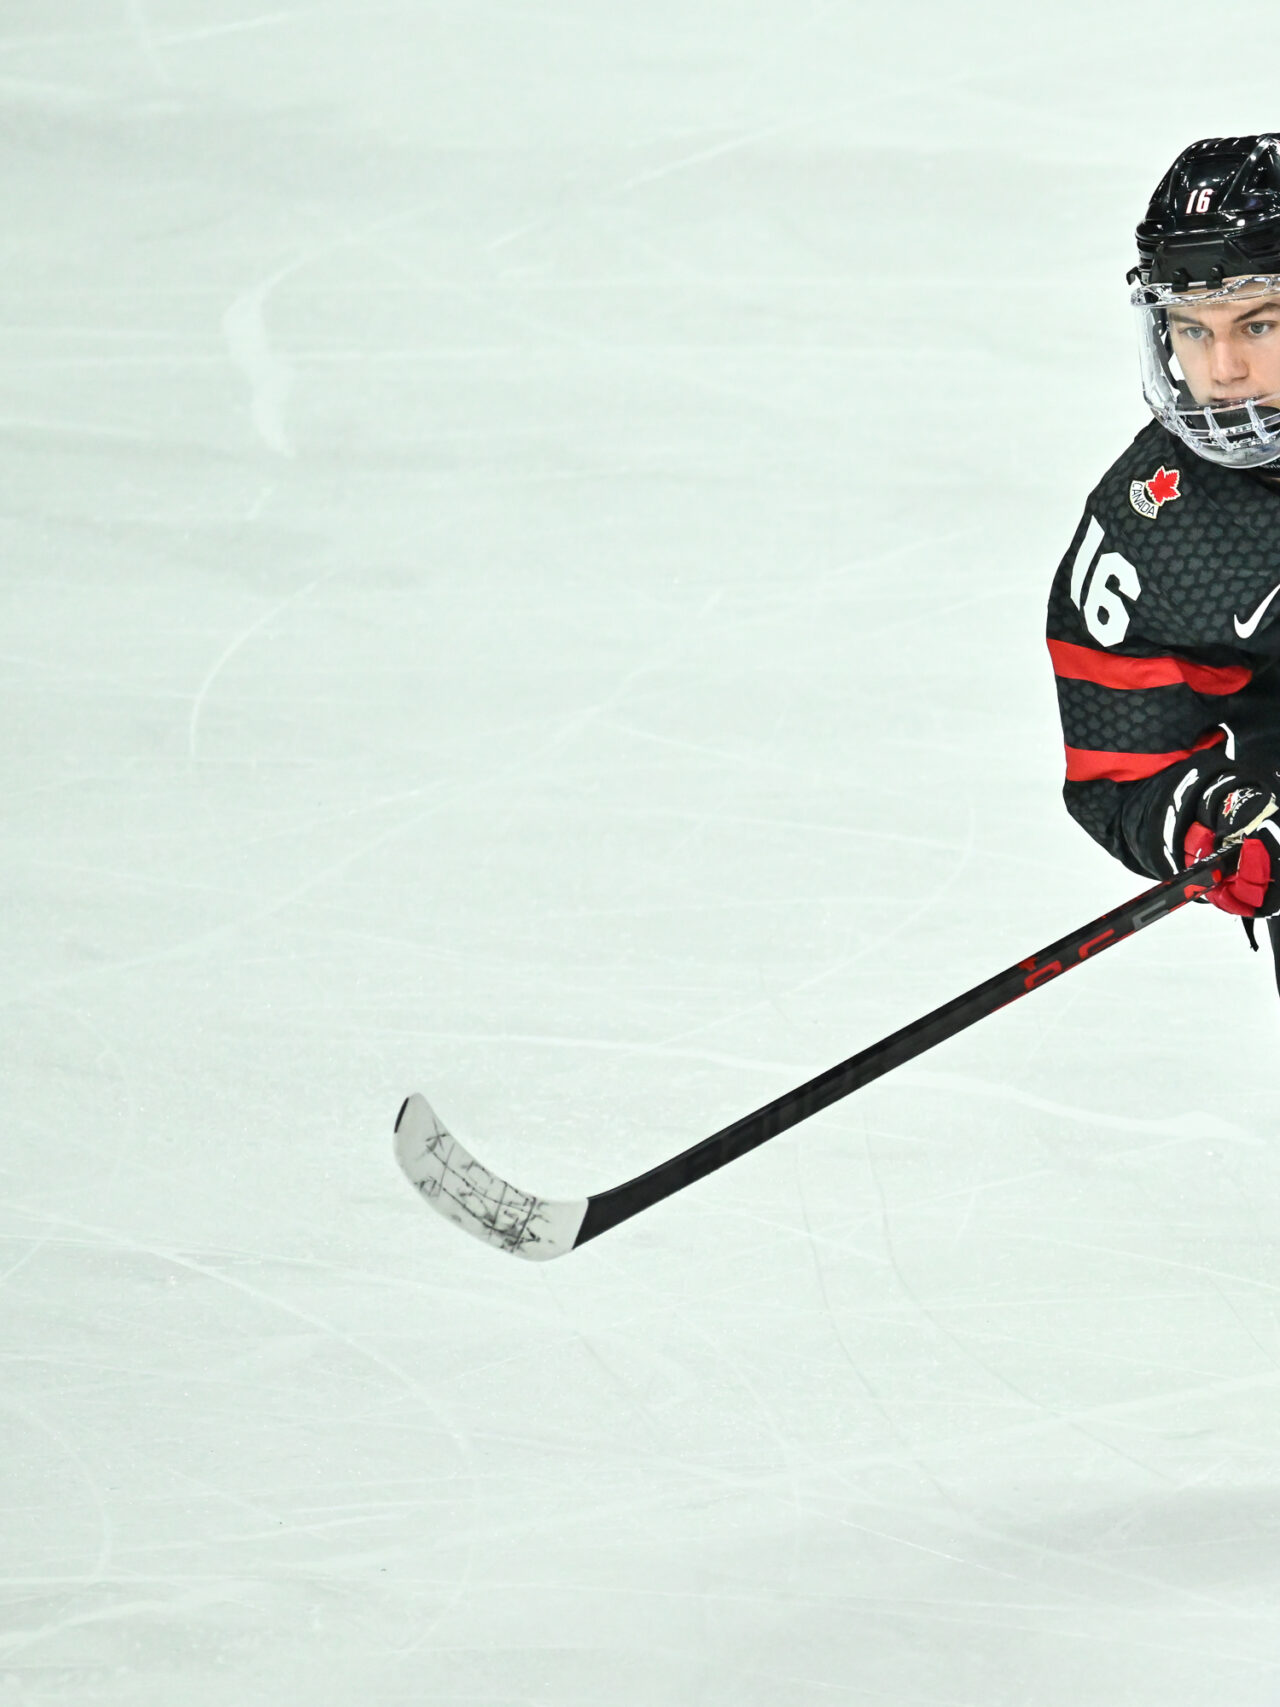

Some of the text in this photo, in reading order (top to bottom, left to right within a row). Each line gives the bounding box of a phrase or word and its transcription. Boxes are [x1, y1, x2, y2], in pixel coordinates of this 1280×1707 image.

[1185, 188, 1214, 214] 16
[1131, 482, 1156, 517] CANADA
[1070, 514, 1142, 648] 16
